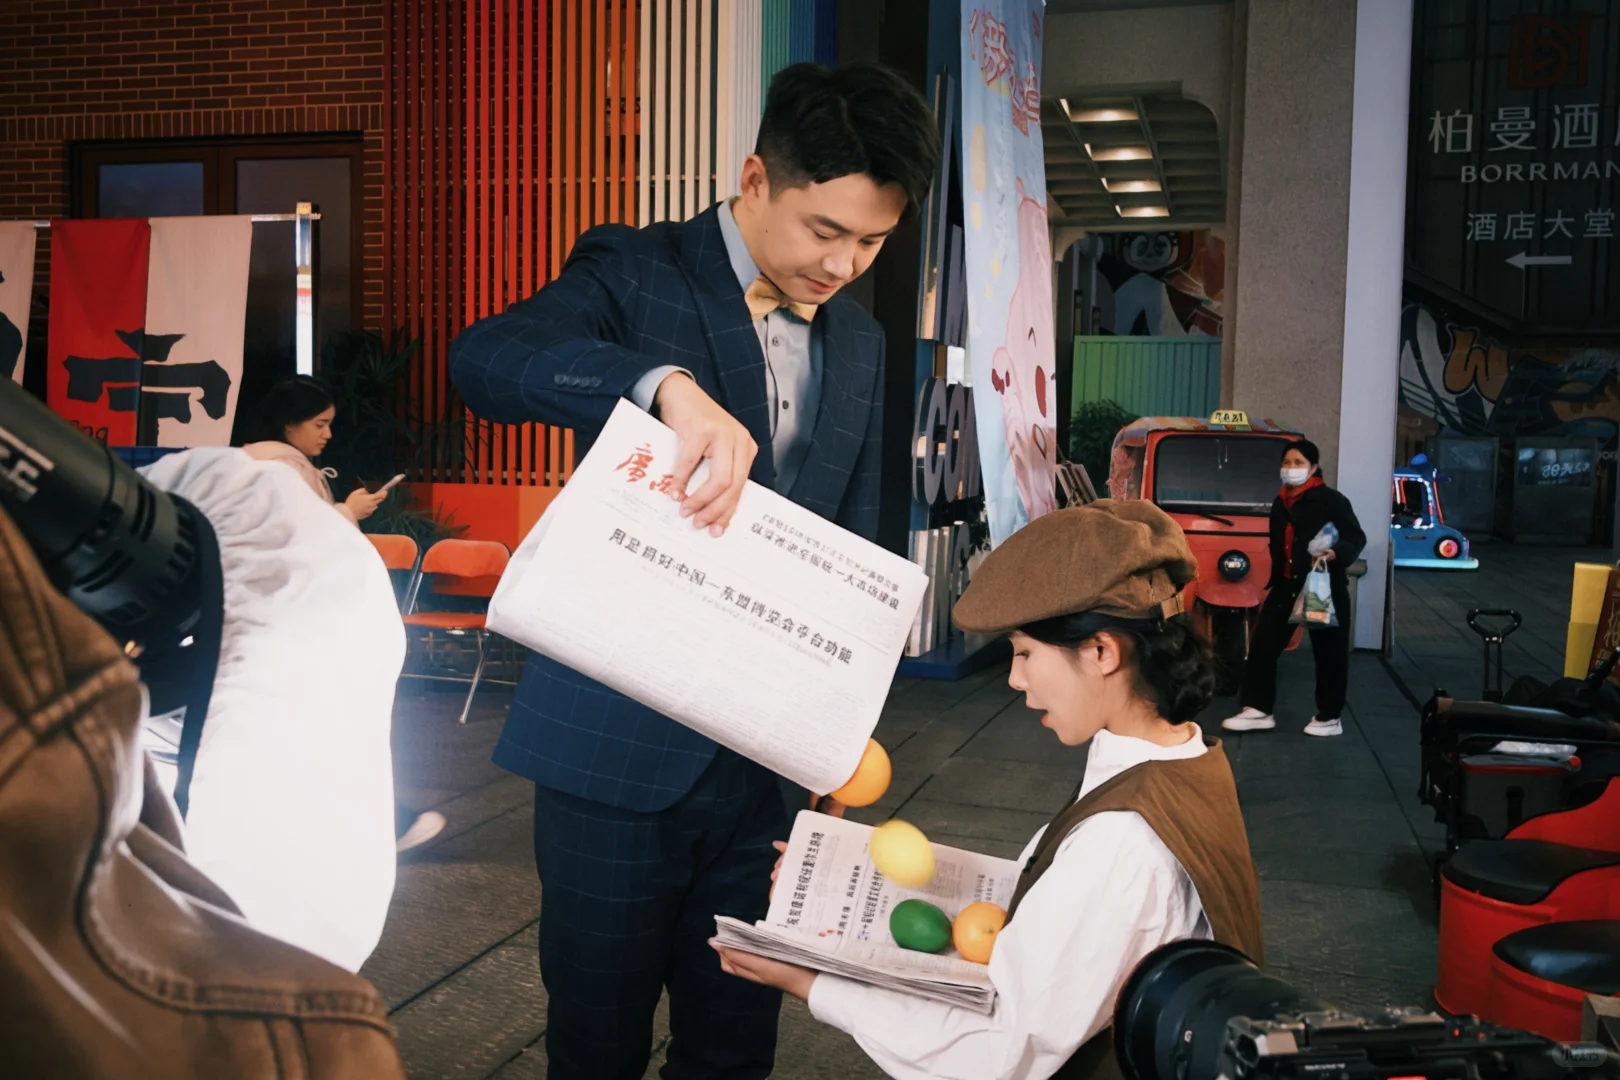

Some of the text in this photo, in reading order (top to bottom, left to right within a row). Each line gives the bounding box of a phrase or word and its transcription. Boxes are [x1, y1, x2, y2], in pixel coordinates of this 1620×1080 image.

[1428, 103, 1620, 154] 柏曼酒
[1466, 207, 1615, 241] 酒店大堂
